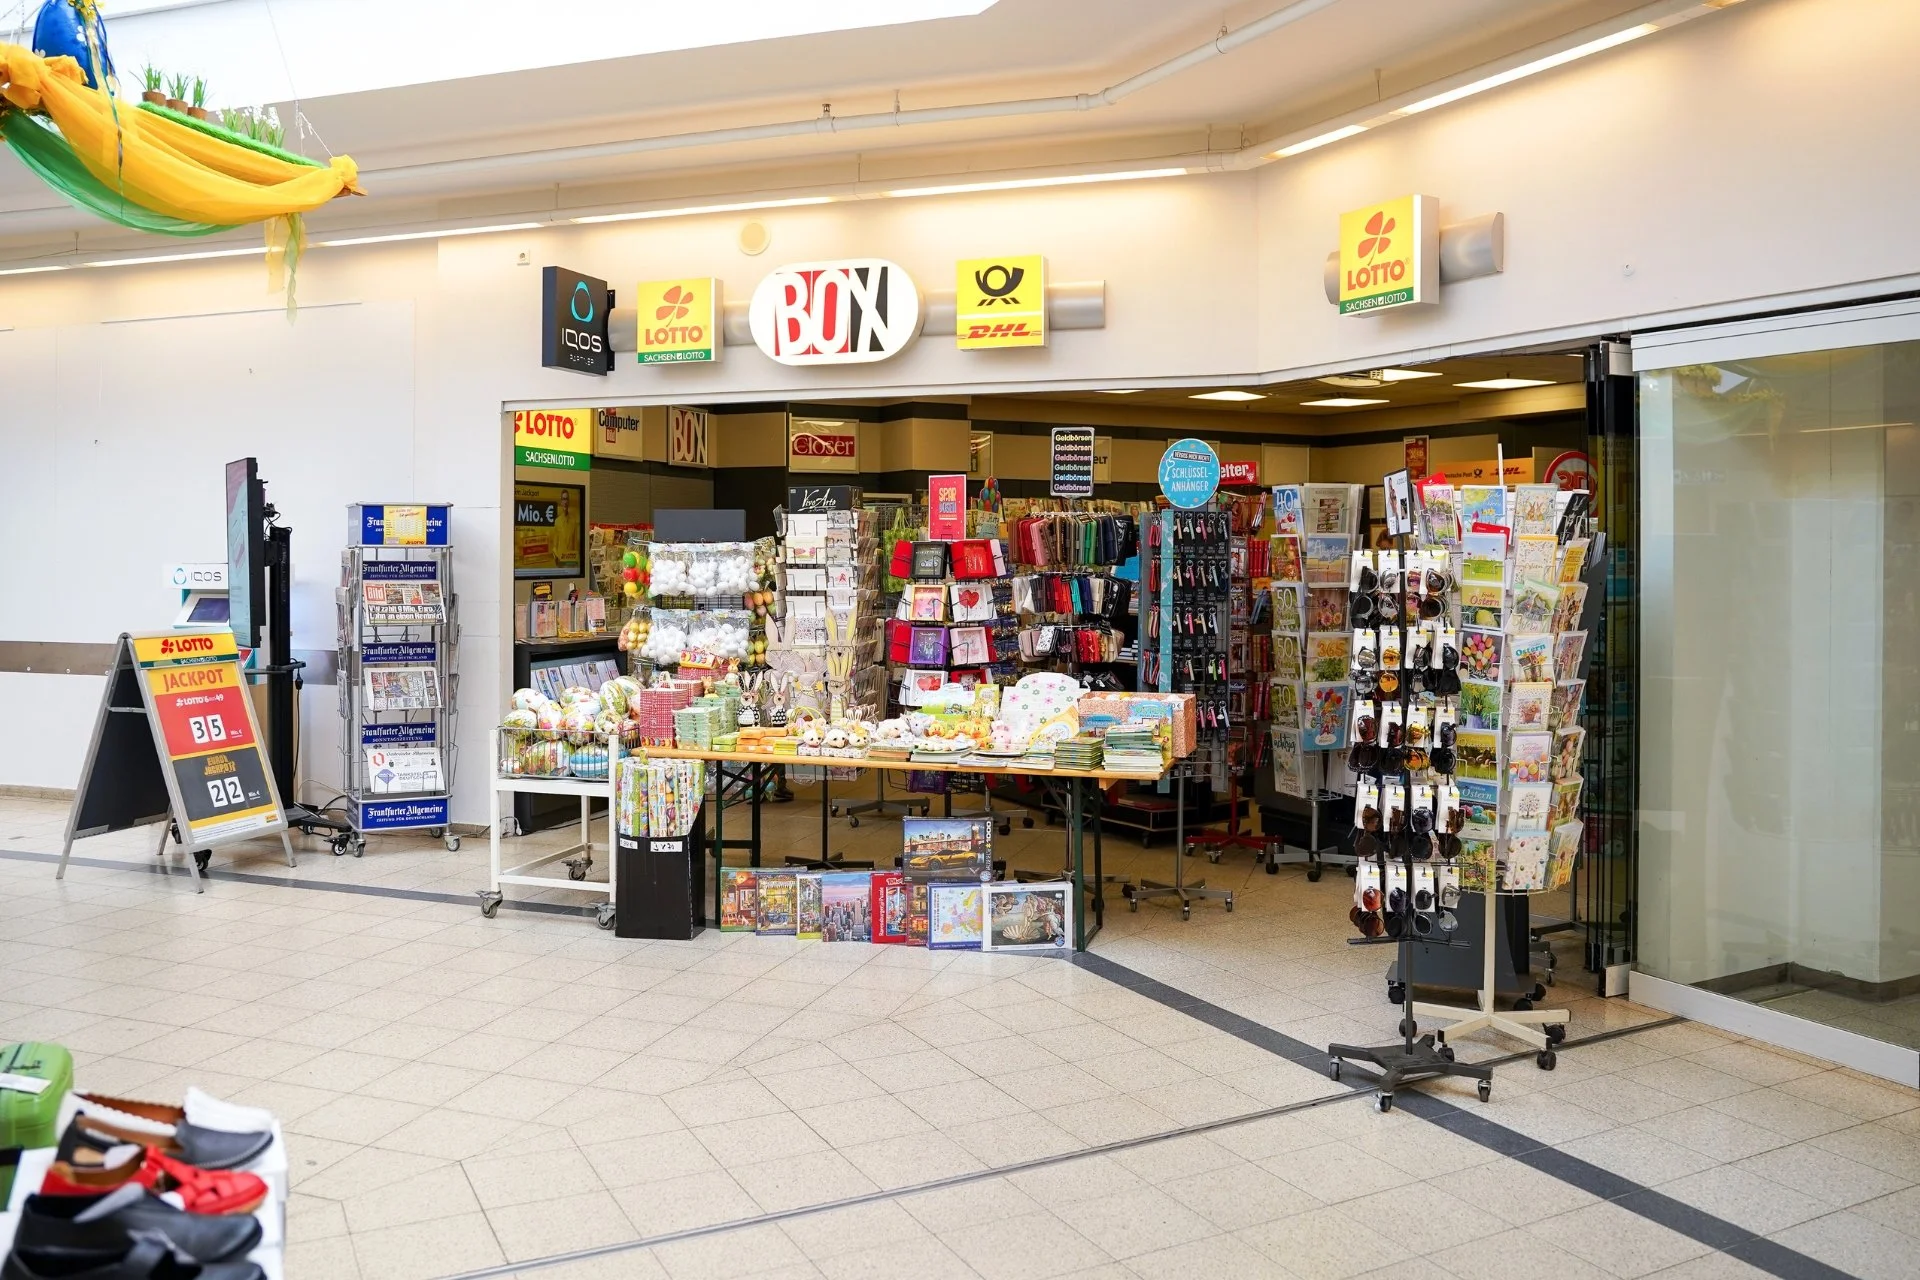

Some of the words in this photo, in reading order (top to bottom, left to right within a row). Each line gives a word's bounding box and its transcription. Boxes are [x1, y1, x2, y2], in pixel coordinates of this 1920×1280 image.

[1347, 259, 1406, 291] LOTTO
[774, 266, 889, 357] BOX
[645, 325, 704, 346] LOTTO
[968, 323, 1031, 339] DHL
[561, 327, 602, 353] IQOS
[525, 409, 575, 440] LOTTO
[598, 409, 640, 433] Computer
[671, 407, 706, 464] BOX
[792, 435, 854, 456] Closer
[524, 451, 575, 467] SACHSENLOTTO
[1054, 463, 1092, 471] Geldbörsen
[1171, 465, 1213, 479] SCHLÜSSEL-
[1220, 463, 1249, 479] elter
[1053, 473, 1091, 481] Geldbörsen
[1053, 483, 1091, 491] Geldbörsen
[1171, 479, 1210, 492] ANHÄNGER
[518, 503, 543, 523] Mio.
[545, 504, 554, 523] €
[399, 563, 435, 574] Allgemeine
[190, 571, 222, 582] IQOS
[366, 586, 385, 601] Bild
[1470, 595, 1500, 607] Ostern
[175, 637, 214, 653] LOTTO
[398, 645, 435, 657] Allgemeine
[1316, 640, 1345, 658] 365
[1515, 643, 1546, 657] Ostern
[162, 668, 224, 693] JACKPOT
[183, 697, 204, 706] LOTTO
[398, 725, 435, 737] Allgemeine
[1461, 789, 1492, 800] Ostern
[367, 806, 406, 819] Frankfurter
[406, 804, 444, 817] Allgemeine
